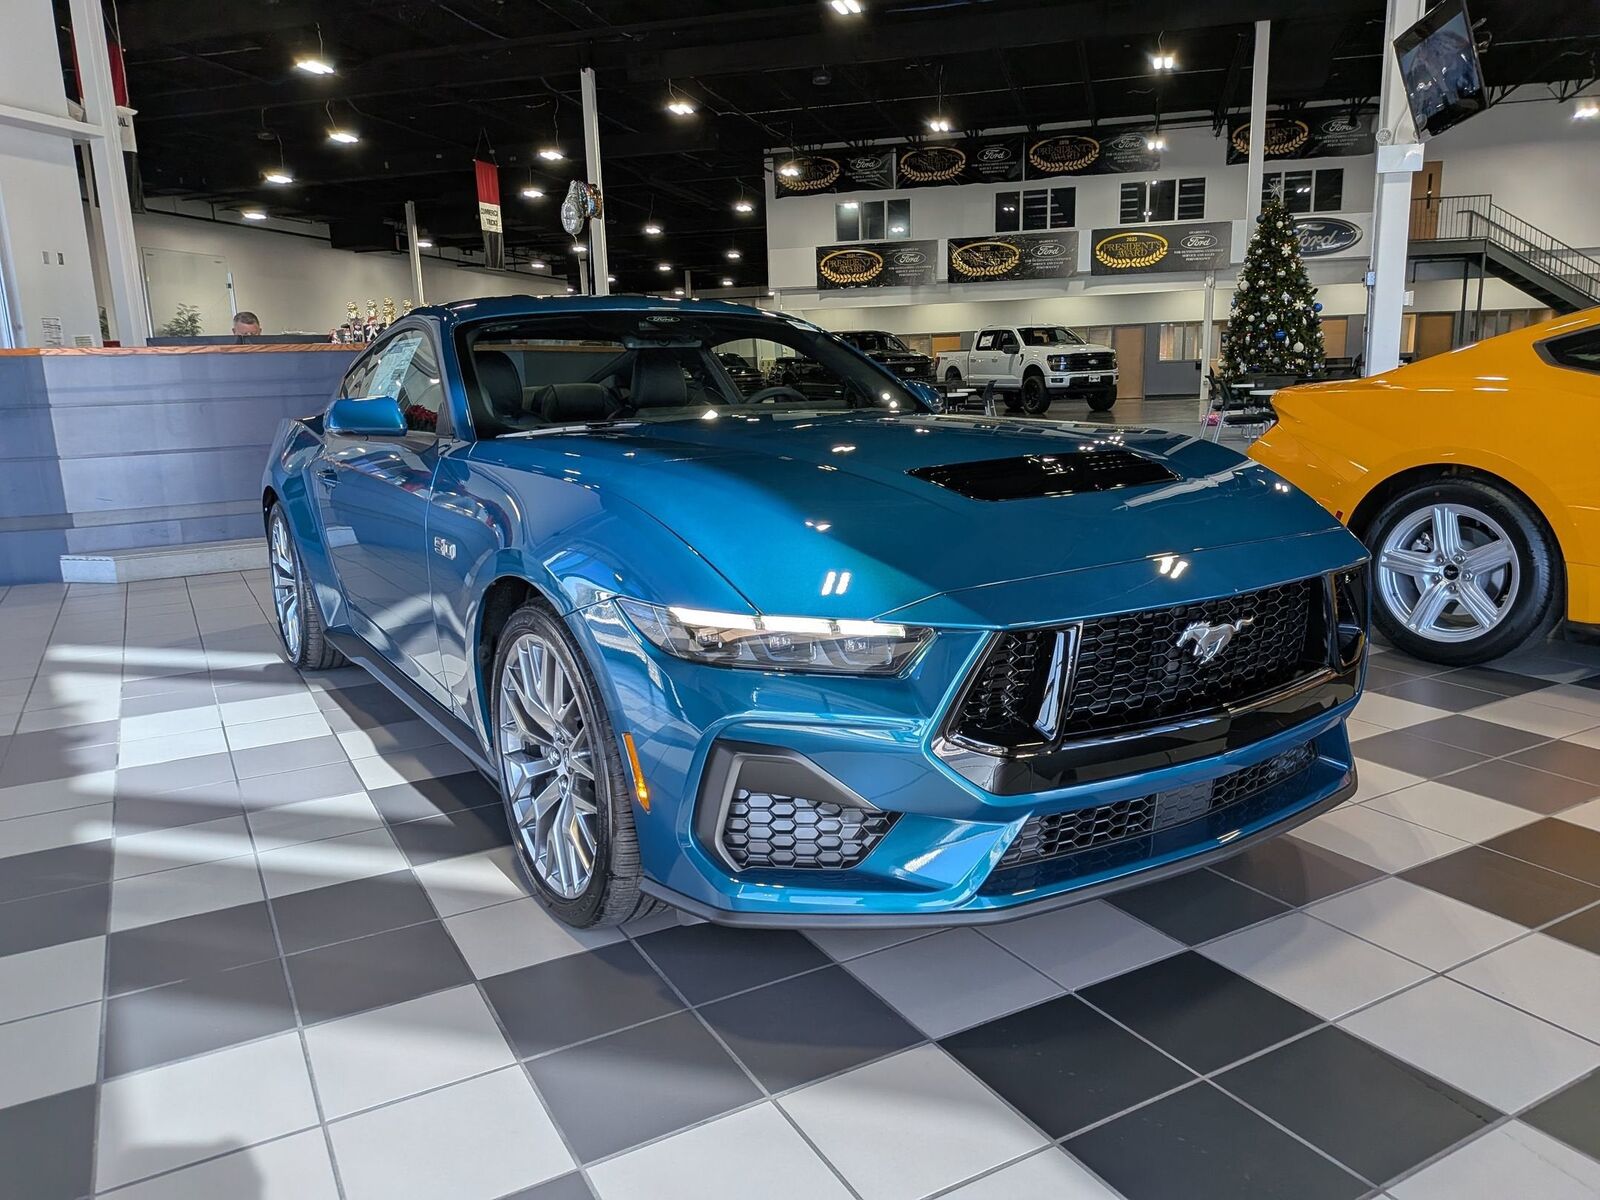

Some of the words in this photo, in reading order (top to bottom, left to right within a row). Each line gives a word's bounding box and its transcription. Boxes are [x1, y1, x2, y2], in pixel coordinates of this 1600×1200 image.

[1118, 137, 1141, 148] Ford
[983, 149, 1006, 160] Ford
[855, 158, 876, 169] Ford
[1103, 240, 1162, 252] PRESIDENT'S
[1187, 236, 1212, 247] Ford
[1037, 245, 1060, 255] Ford
[1115, 248, 1148, 258] AWARD
[899, 253, 920, 263] Ford
